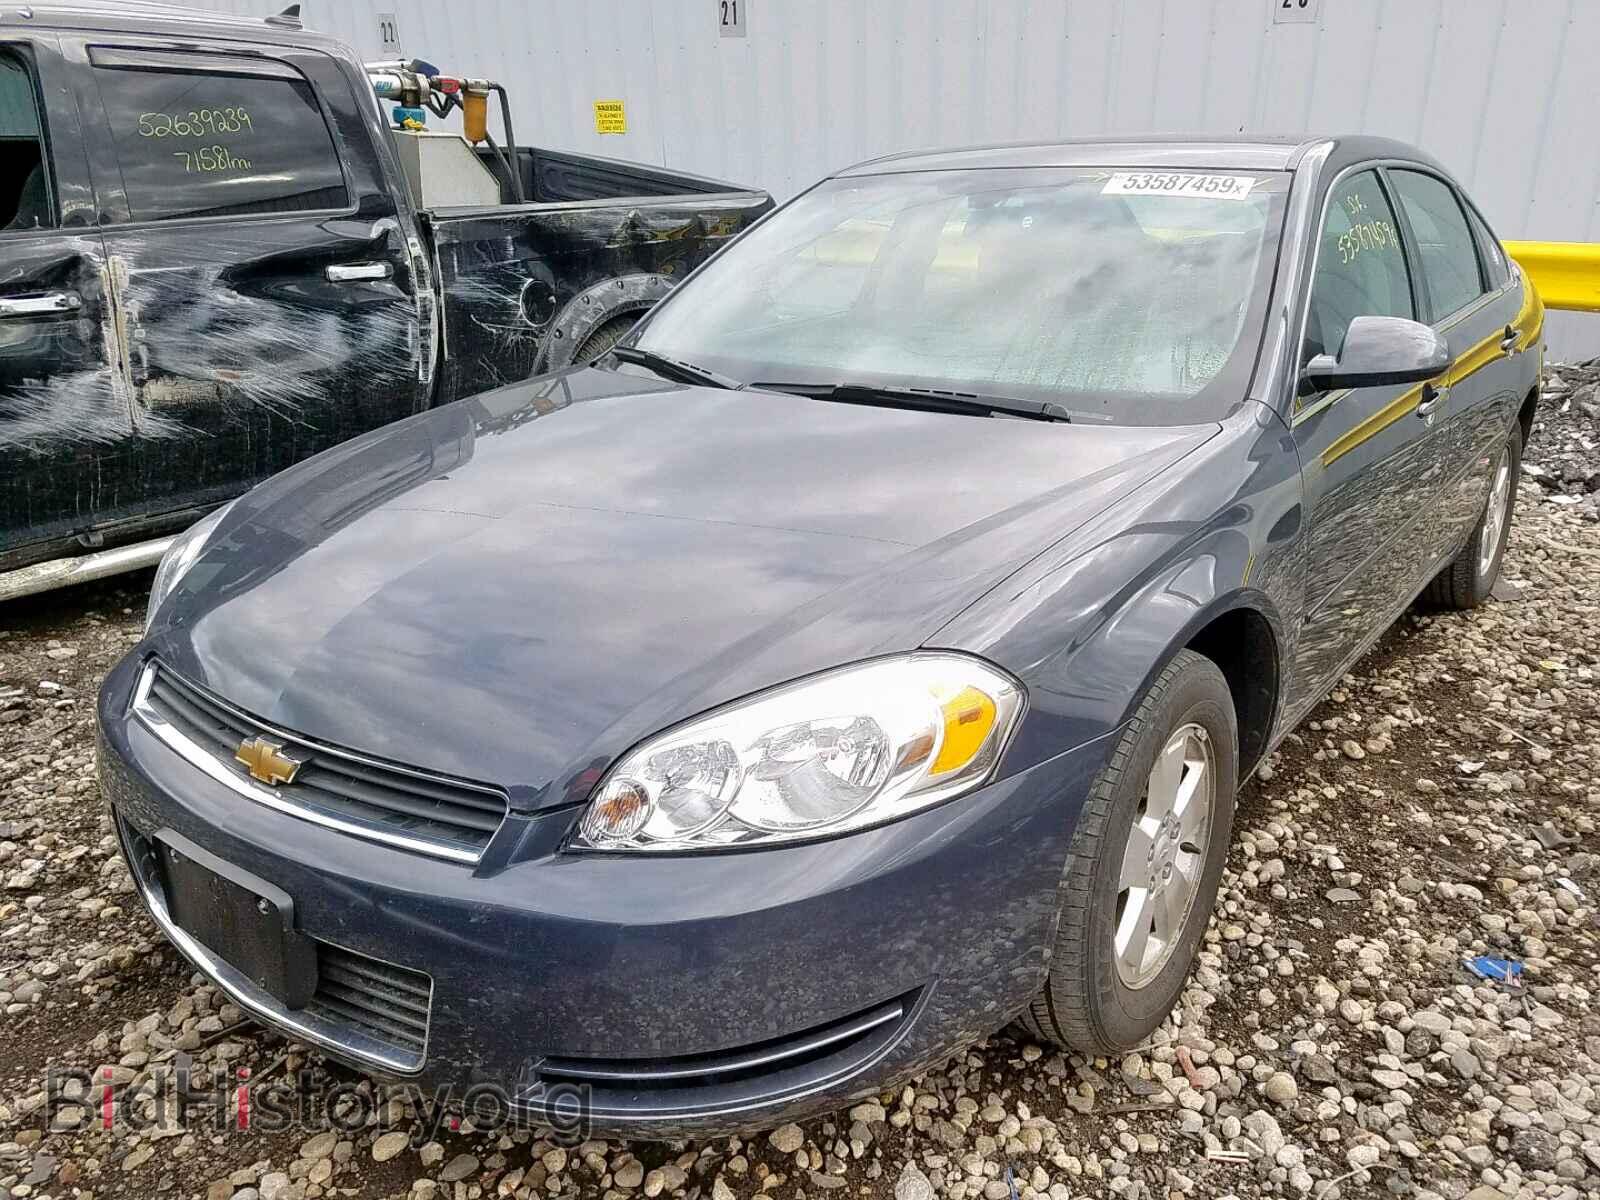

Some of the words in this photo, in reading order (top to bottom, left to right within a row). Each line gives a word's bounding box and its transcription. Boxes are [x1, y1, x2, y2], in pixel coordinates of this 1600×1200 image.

[721, 0, 737, 25] 21
[380, 22, 395, 43] 22
[139, 107, 255, 137] 52639239
